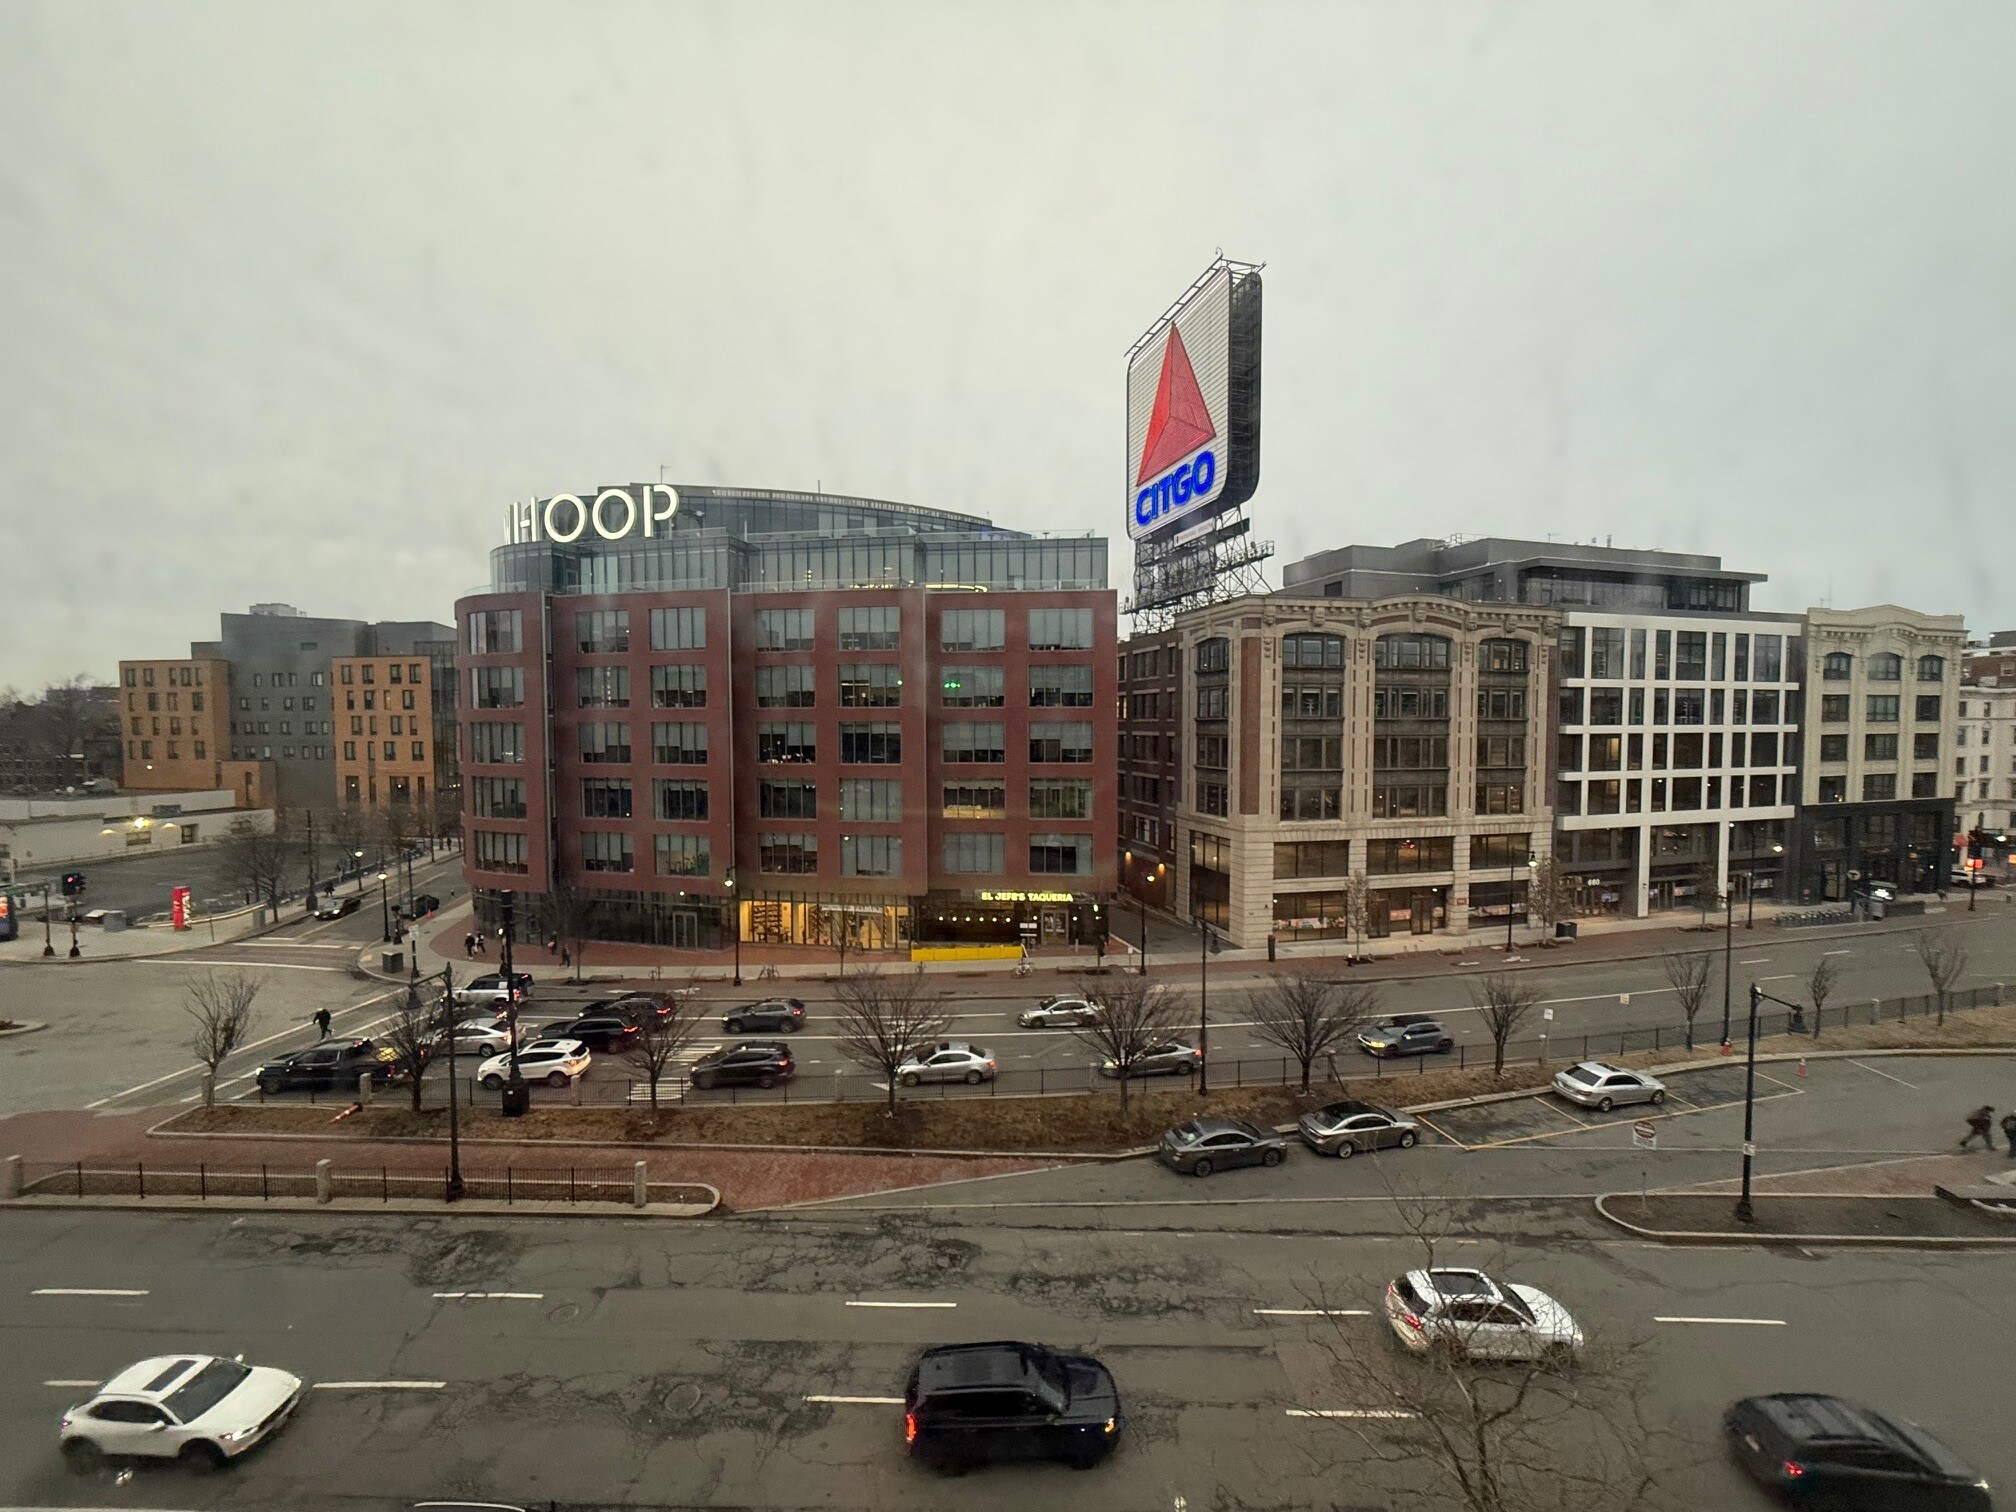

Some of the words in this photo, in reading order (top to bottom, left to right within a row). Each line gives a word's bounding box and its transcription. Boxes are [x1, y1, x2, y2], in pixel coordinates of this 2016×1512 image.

[1136, 450, 1215, 526] CITGO
[981, 891, 994, 901] EL
[994, 892, 1026, 902] JEFE'S
[1027, 892, 1073, 903] TAQUERIA
